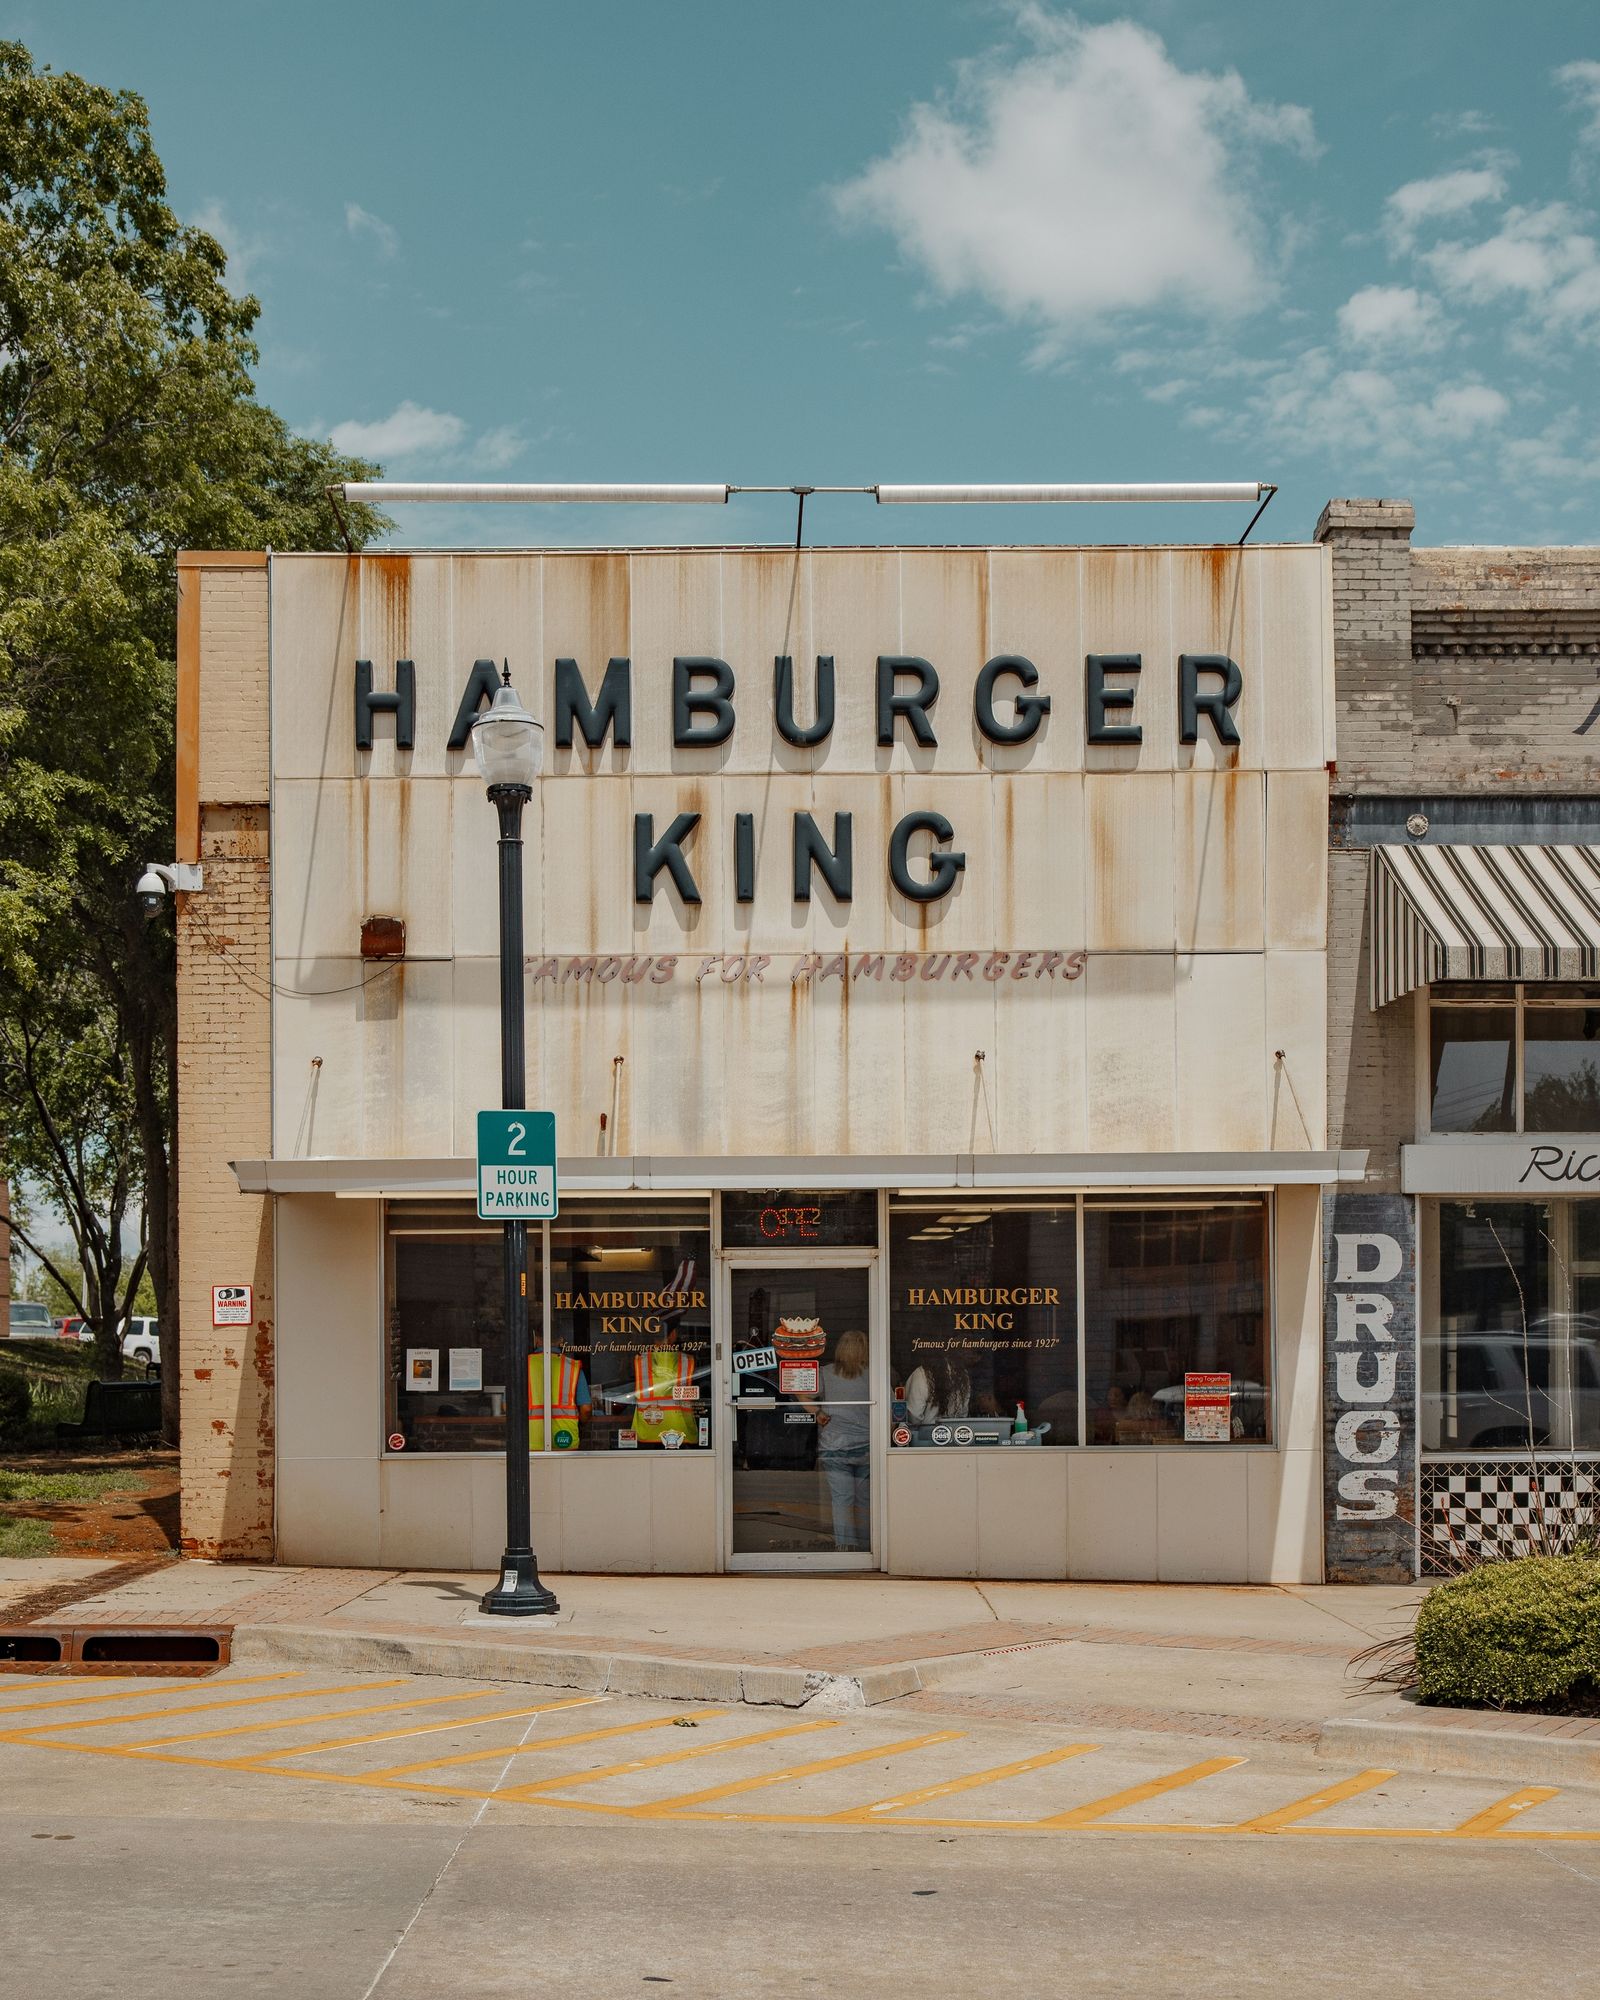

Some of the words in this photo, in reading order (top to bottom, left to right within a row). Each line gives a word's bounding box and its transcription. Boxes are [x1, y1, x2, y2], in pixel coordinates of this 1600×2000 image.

[354, 653, 1246, 751] HAMBURGER
[634, 810, 967, 905] KING
[695, 955, 771, 983] FOR
[789, 951, 1088, 982] HAMBURGERS
[507, 1122, 527, 1156] 2
[1518, 1146, 1600, 1182] Ric
[497, 1170, 537, 1185] HOUR
[486, 1192, 550, 1207] PARKING
[218, 1300, 247, 1308] WARNING
[555, 1291, 707, 1309] HAMBURGER
[908, 1288, 1060, 1305] HAMBURGER
[601, 1316, 662, 1334] KING
[954, 1312, 1014, 1330] KING
[592, 1341, 608, 1355] for
[609, 1341, 656, 1354] hamburgers
[656, 1342, 680, 1352] since
[945, 1338, 960, 1351] for
[962, 1338, 1009, 1350] hamburgers
[1011, 1339, 1032, 1348] since
[736, 1350, 775, 1370] OPEN
[1334, 1233, 1403, 1521] DRUGS
